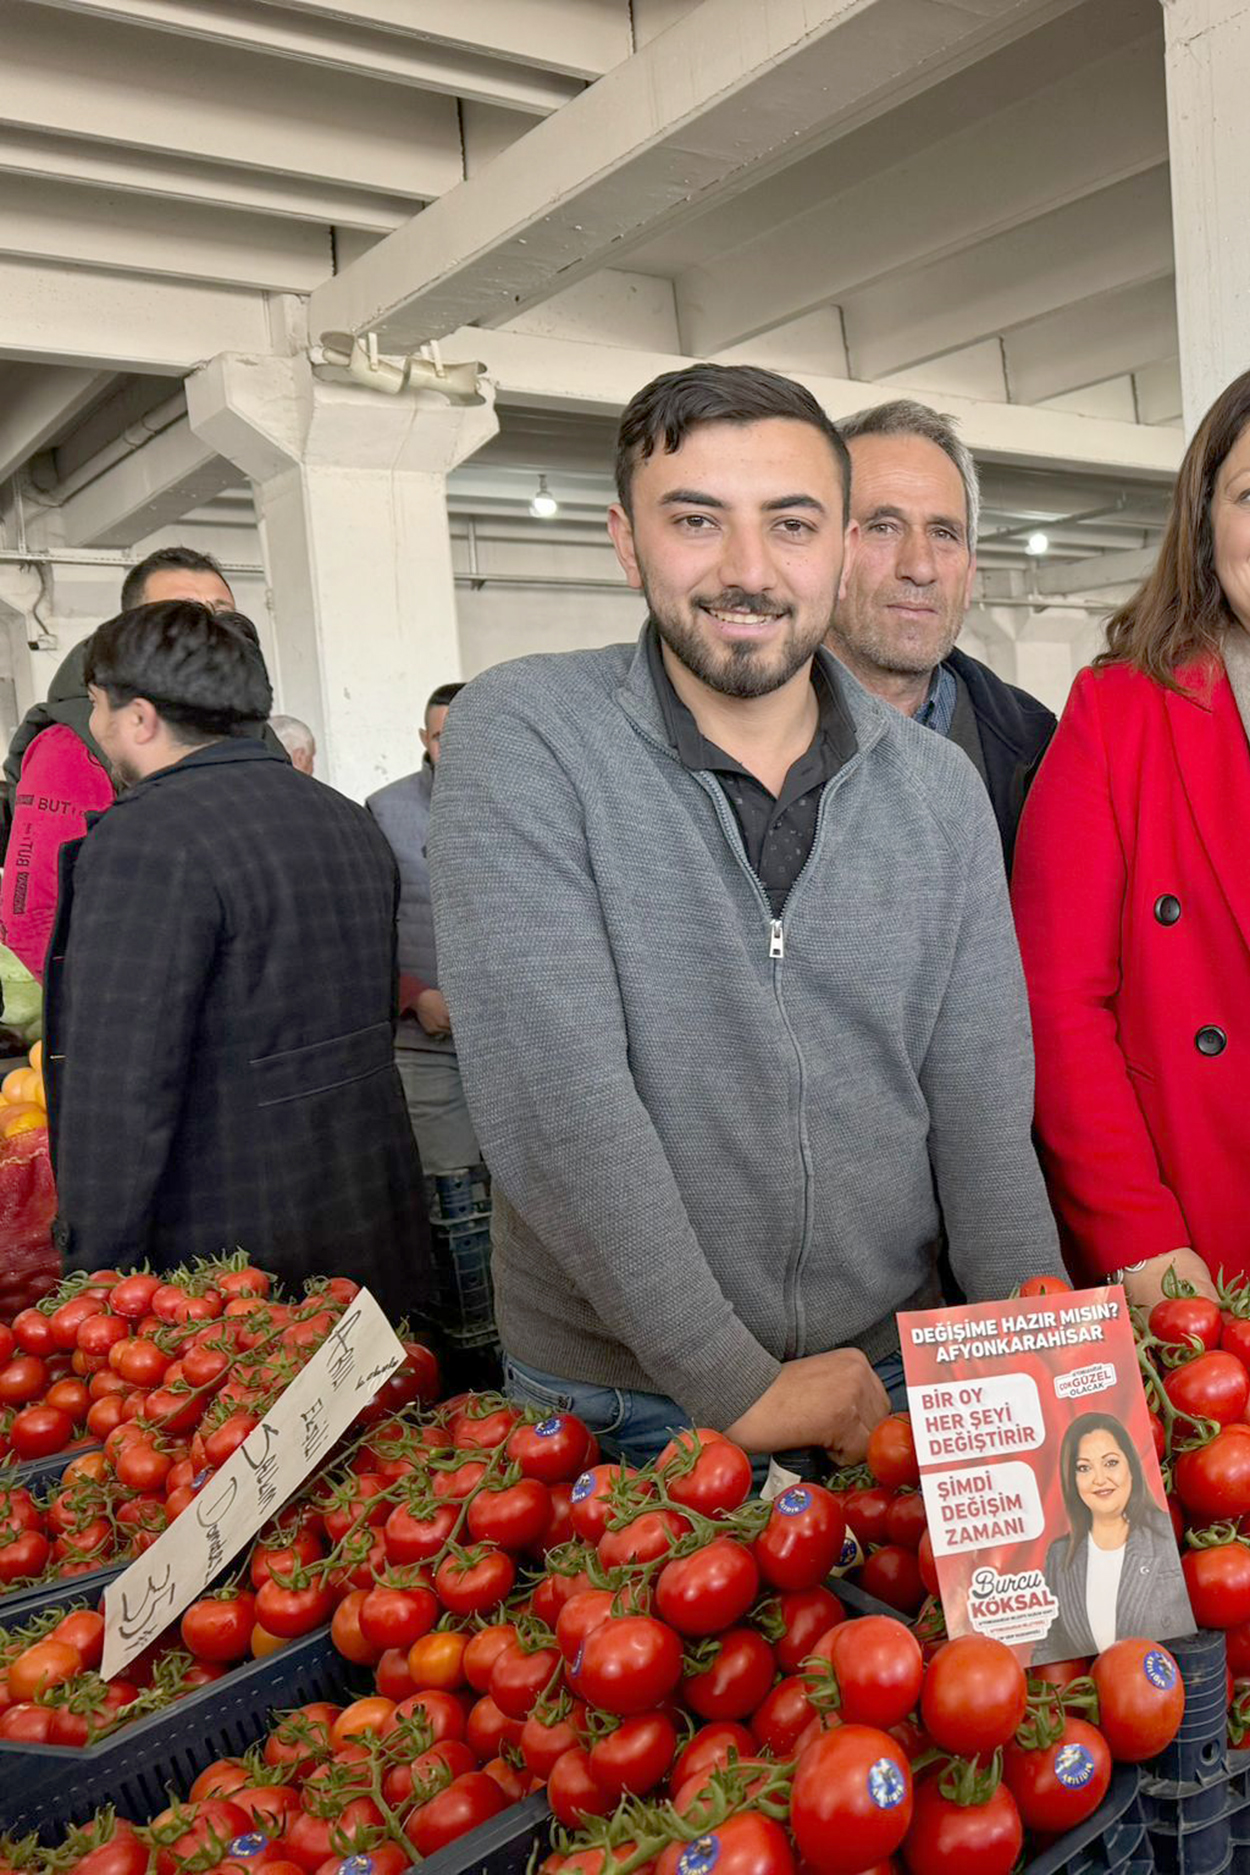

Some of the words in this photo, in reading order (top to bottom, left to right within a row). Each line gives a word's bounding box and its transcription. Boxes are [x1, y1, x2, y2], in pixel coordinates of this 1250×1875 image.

[911, 1319, 998, 1345] DEĞİŞİME
[1002, 1311, 1056, 1333] HAZIR
[1060, 1302, 1119, 1326] MISIN?
[936, 1324, 1104, 1363] AFYONKARAHİSAR
[1069, 1381, 1104, 1397] OLACAK
[1072, 1370, 1111, 1389] GÜZEL
[921, 1388, 953, 1410] BİR
[959, 1387, 983, 1406] OY
[925, 1412, 966, 1433] HER
[970, 1402, 1012, 1431] ŞEYİ
[929, 1423, 1036, 1456] DEĞİŞTİRİR
[937, 1470, 992, 1502] ŞİMDİ
[941, 1492, 1023, 1523] DEĞİŞİM
[945, 1517, 1025, 1547] ZAMANI
[971, 1571, 1043, 1599] Burcu
[970, 1589, 1056, 1619] KÖKSAL
